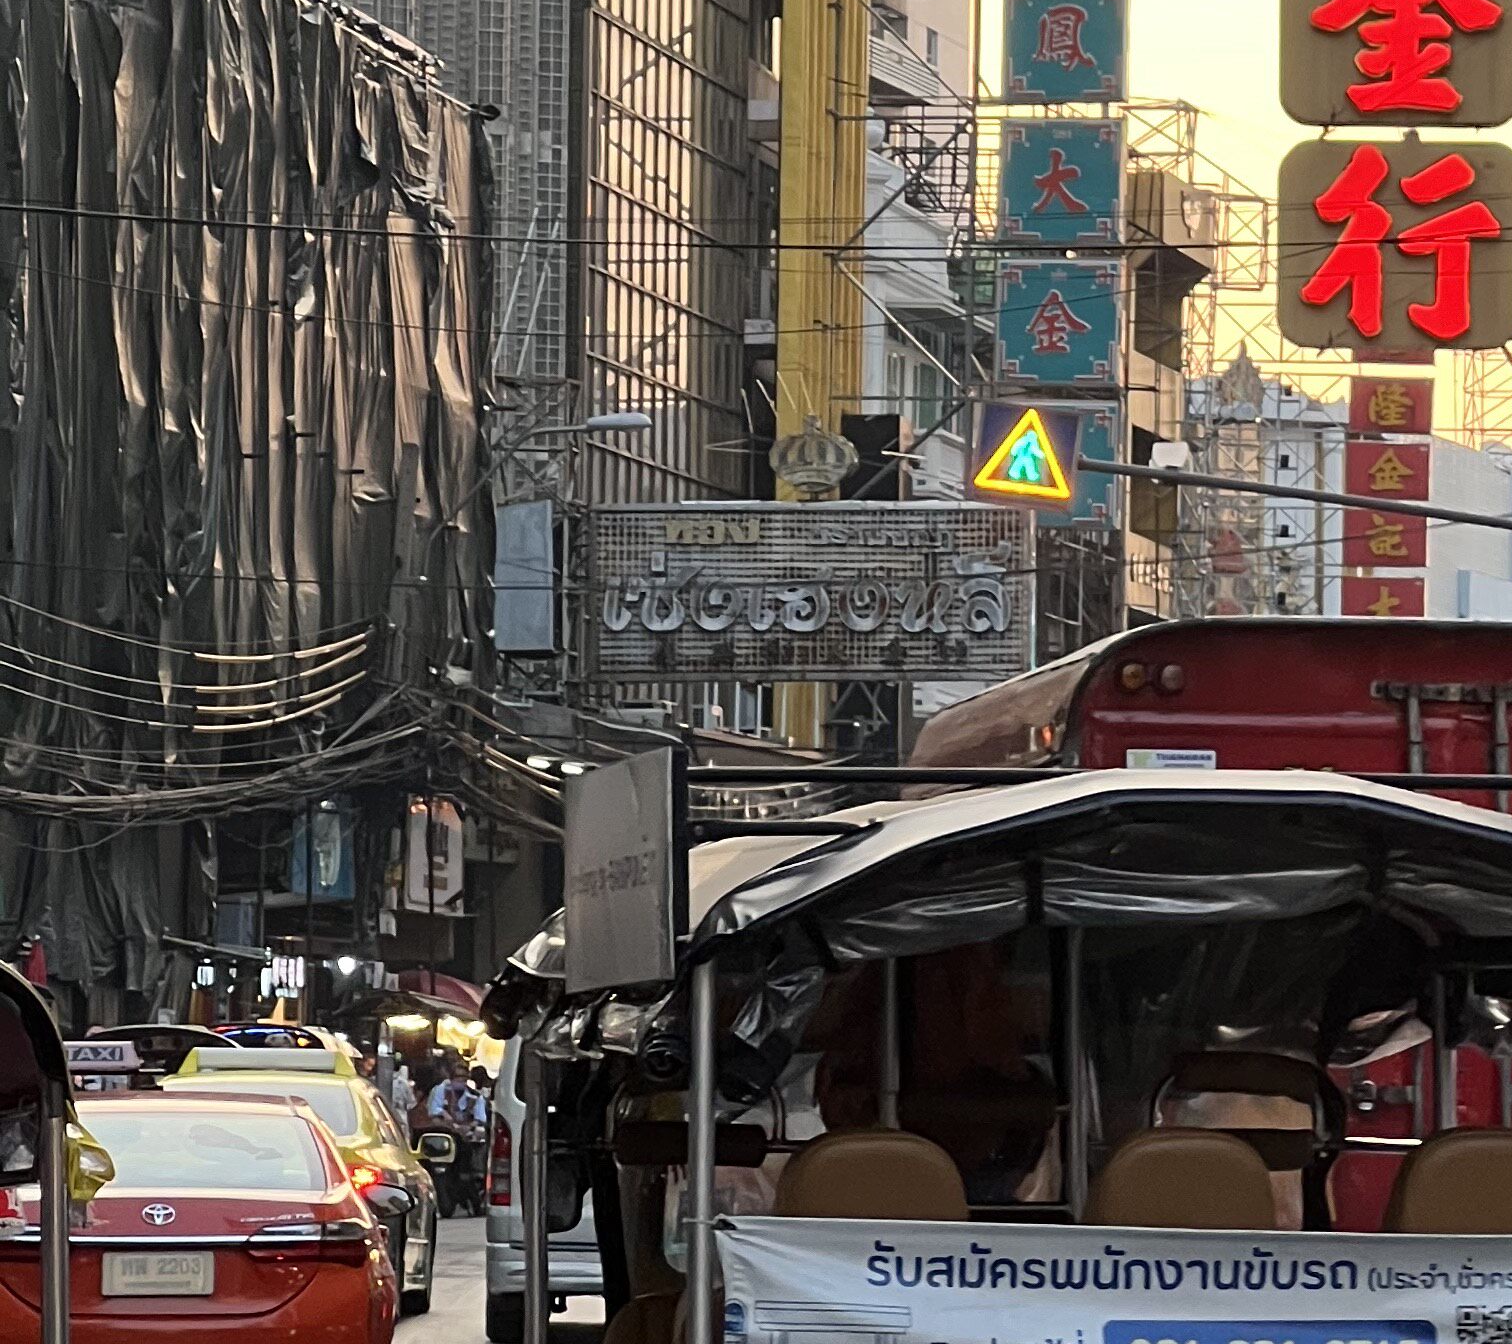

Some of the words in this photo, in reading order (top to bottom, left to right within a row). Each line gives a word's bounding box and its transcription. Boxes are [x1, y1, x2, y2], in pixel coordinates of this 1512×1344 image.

[68, 1047, 121, 1061] TAXI
[865, 1239, 1358, 1292] รับสมัครพนักงานขับรถ
